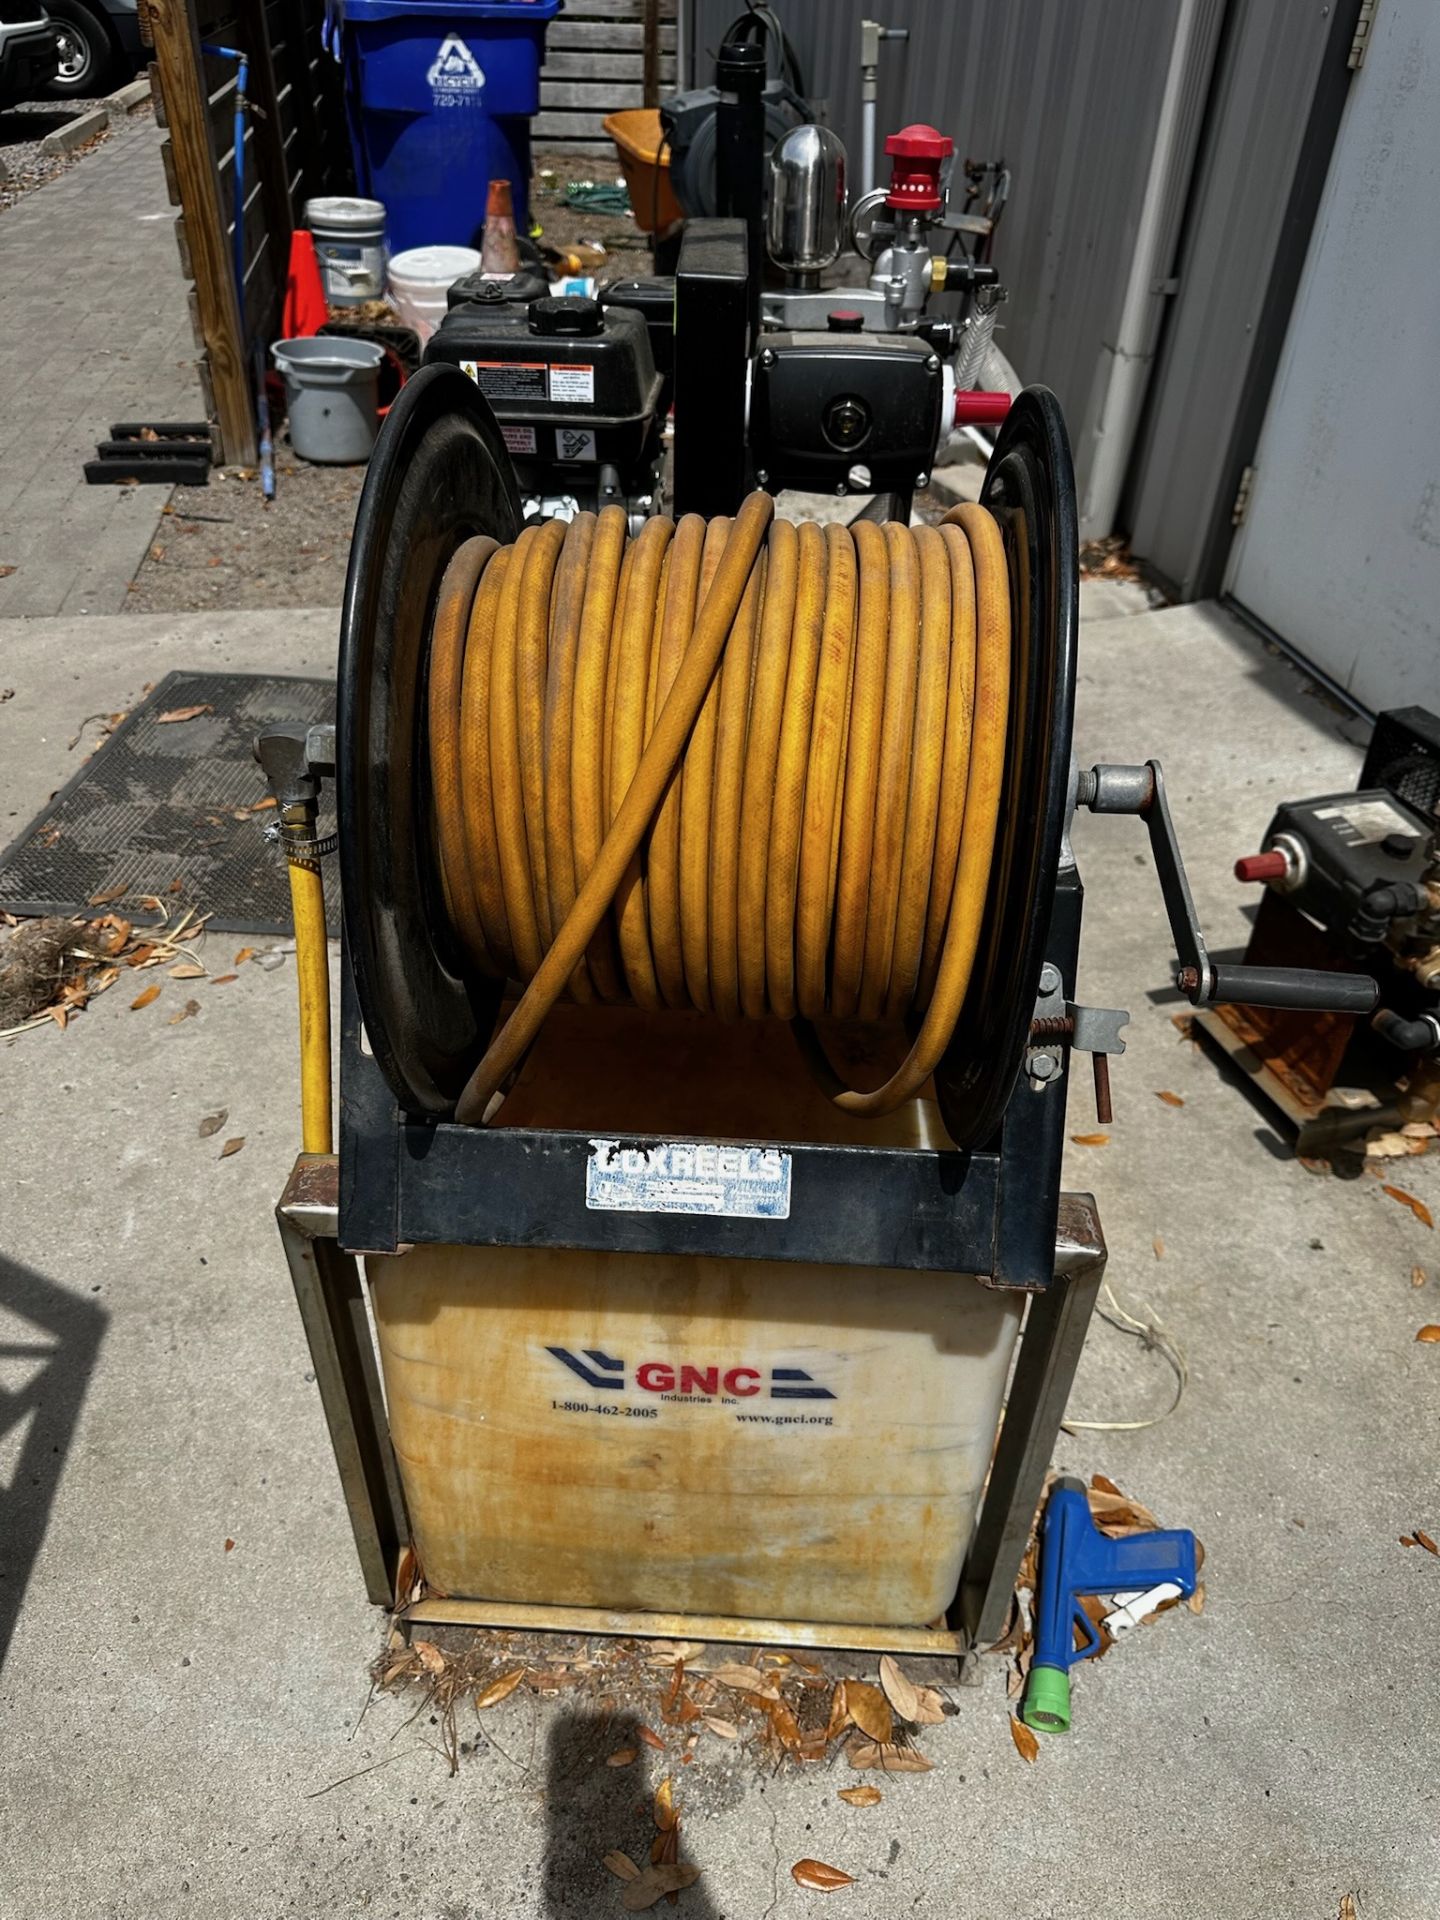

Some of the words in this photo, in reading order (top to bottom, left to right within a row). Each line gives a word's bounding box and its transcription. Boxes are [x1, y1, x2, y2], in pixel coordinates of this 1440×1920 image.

[636, 1363, 761, 1397] GNC
[660, 1393, 712, 1404] Industries
[551, 1400, 658, 1418] 1-800-462-2005
[736, 1413, 834, 1426] www.gnci.org
